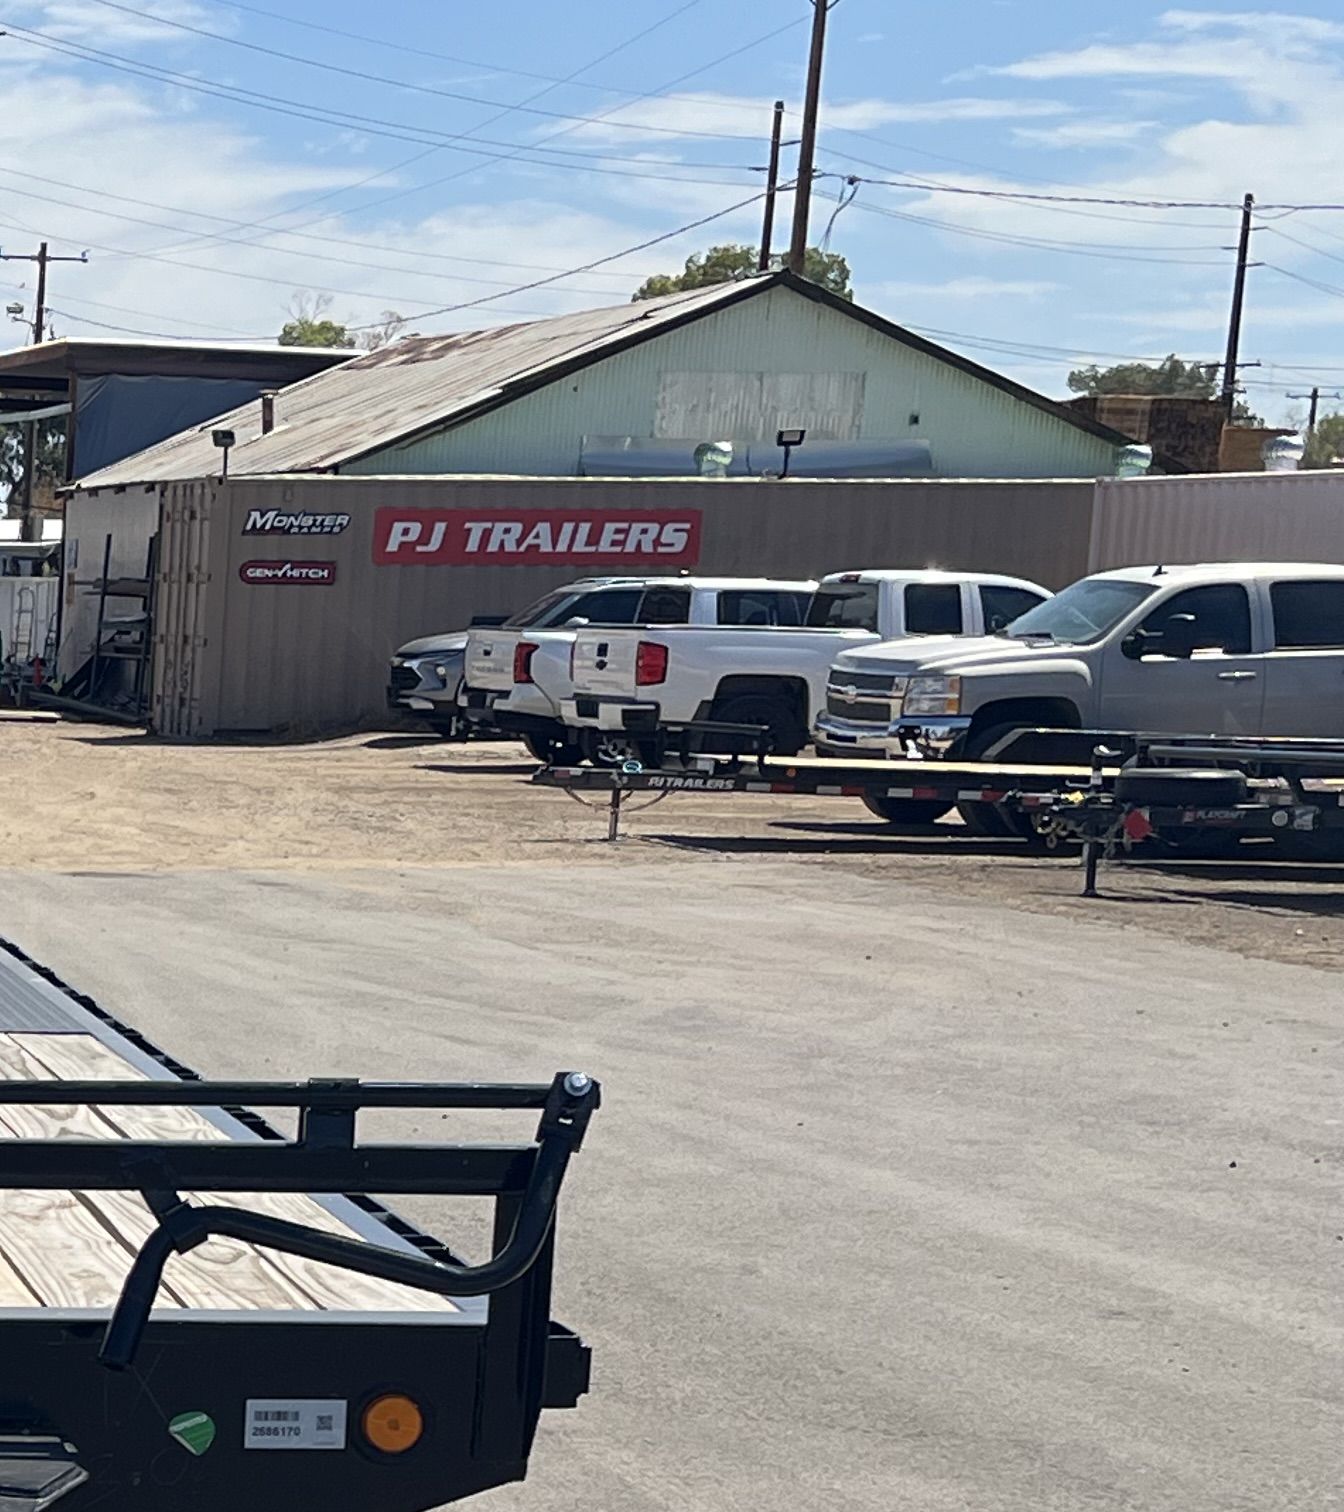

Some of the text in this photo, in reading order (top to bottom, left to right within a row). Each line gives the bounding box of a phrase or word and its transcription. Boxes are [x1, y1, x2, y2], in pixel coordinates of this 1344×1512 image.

[245, 510, 350, 530] MONSTER
[385, 521, 691, 553] PJ TRAILERS
